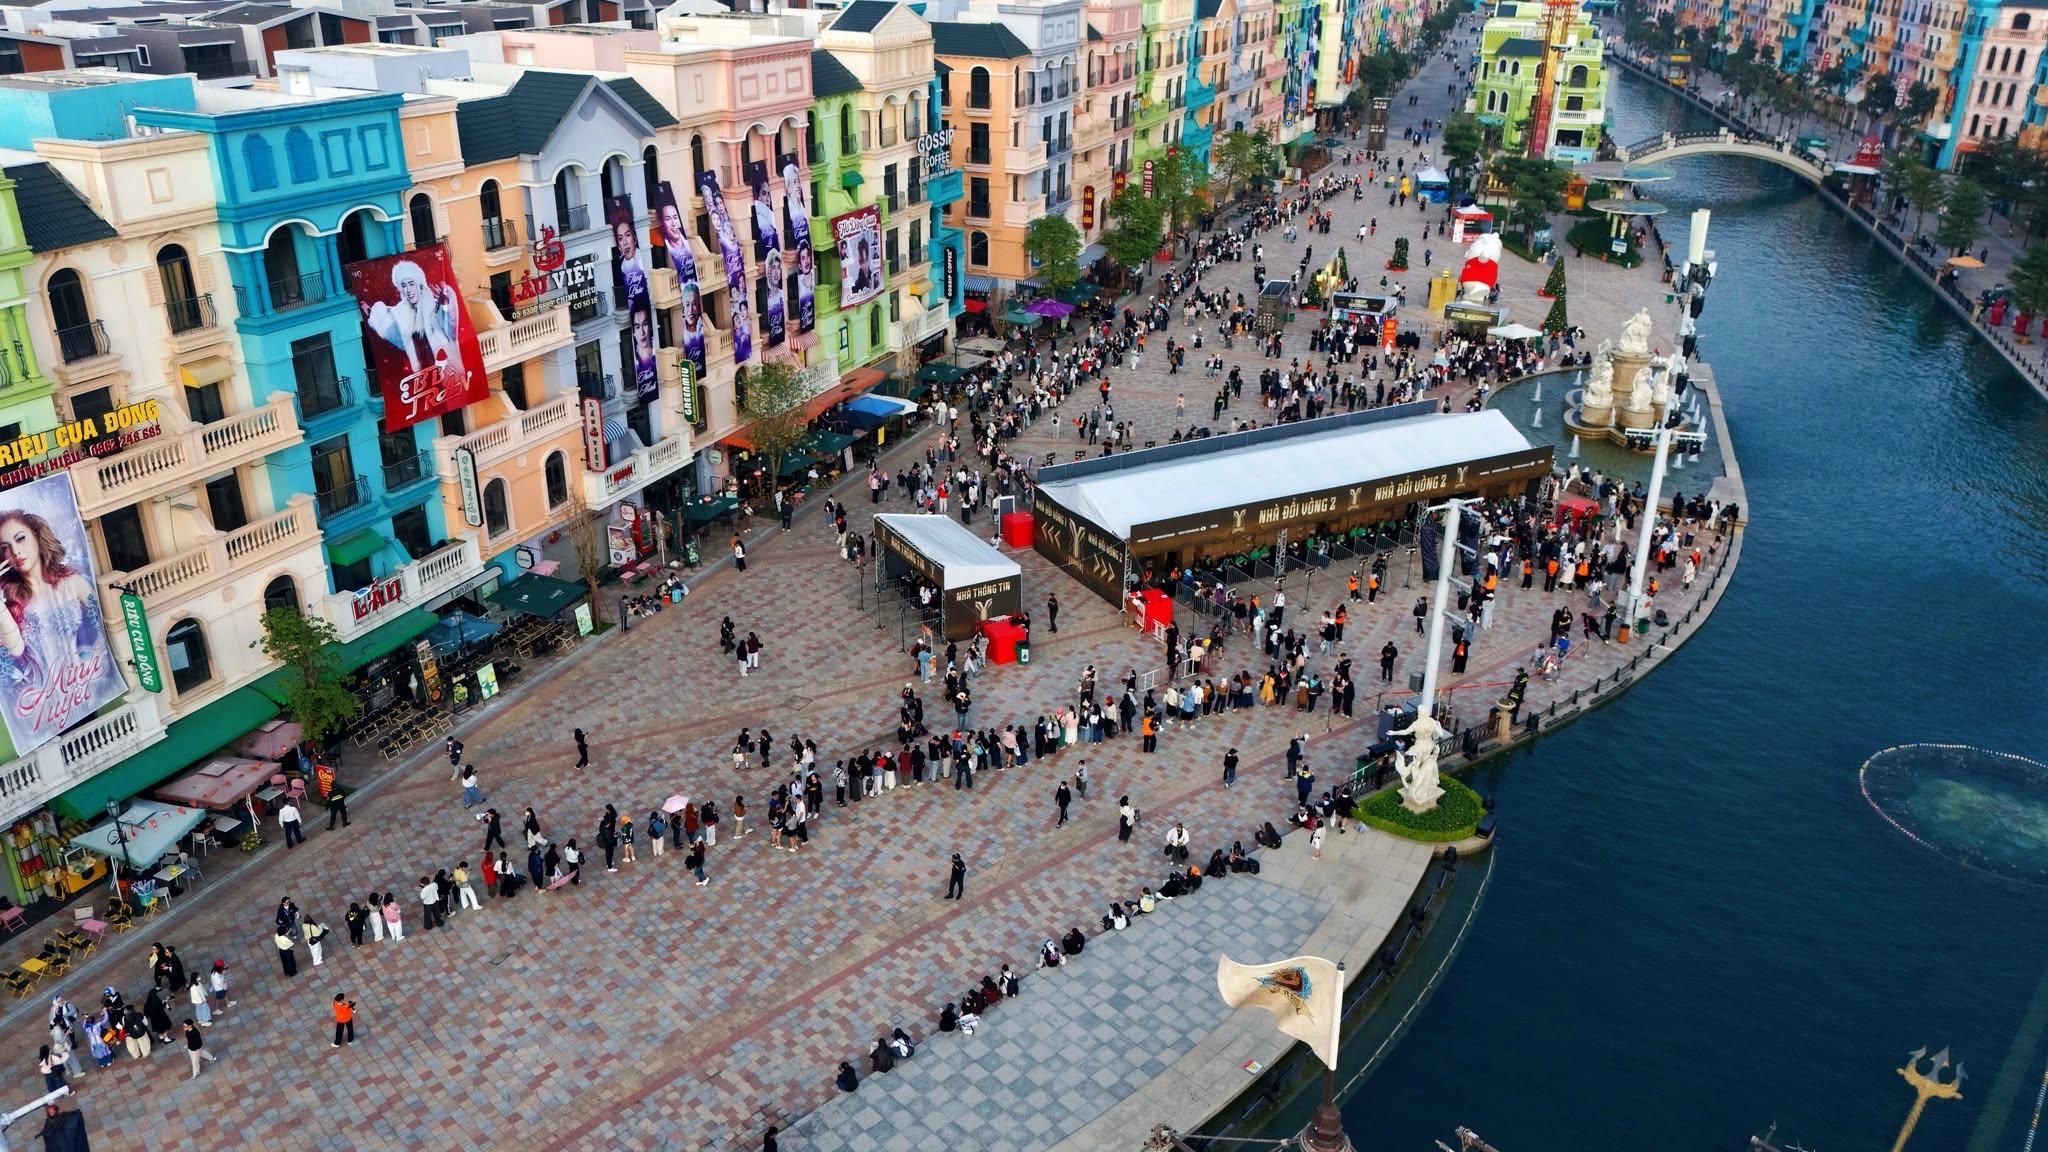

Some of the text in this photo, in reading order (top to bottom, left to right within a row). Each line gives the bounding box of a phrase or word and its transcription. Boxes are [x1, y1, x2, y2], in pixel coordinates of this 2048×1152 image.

[917, 129, 954, 153] GOSSIP
[924, 151, 950, 168] COFFEE
[508, 261, 595, 303] LẨU VIỆT
[681, 367, 692, 415] GREENMIU
[55, 418, 98, 447] CUA
[0, 463, 46, 487] CHÍNH
[119, 431, 140, 448] 248
[142, 424, 162, 441] 685
[1374, 481, 1394, 501] NHÀ
[1414, 475, 1439, 493] VÒNG
[1440, 474, 1447, 489] 2
[1258, 496, 1337, 524] NHÀ ĐỔI VÒNG 2
[352, 576, 401, 620] LẨU
[956, 580, 1011, 602] NHÀ THÔNG TIN
[132, 629, 145, 651] CUA
